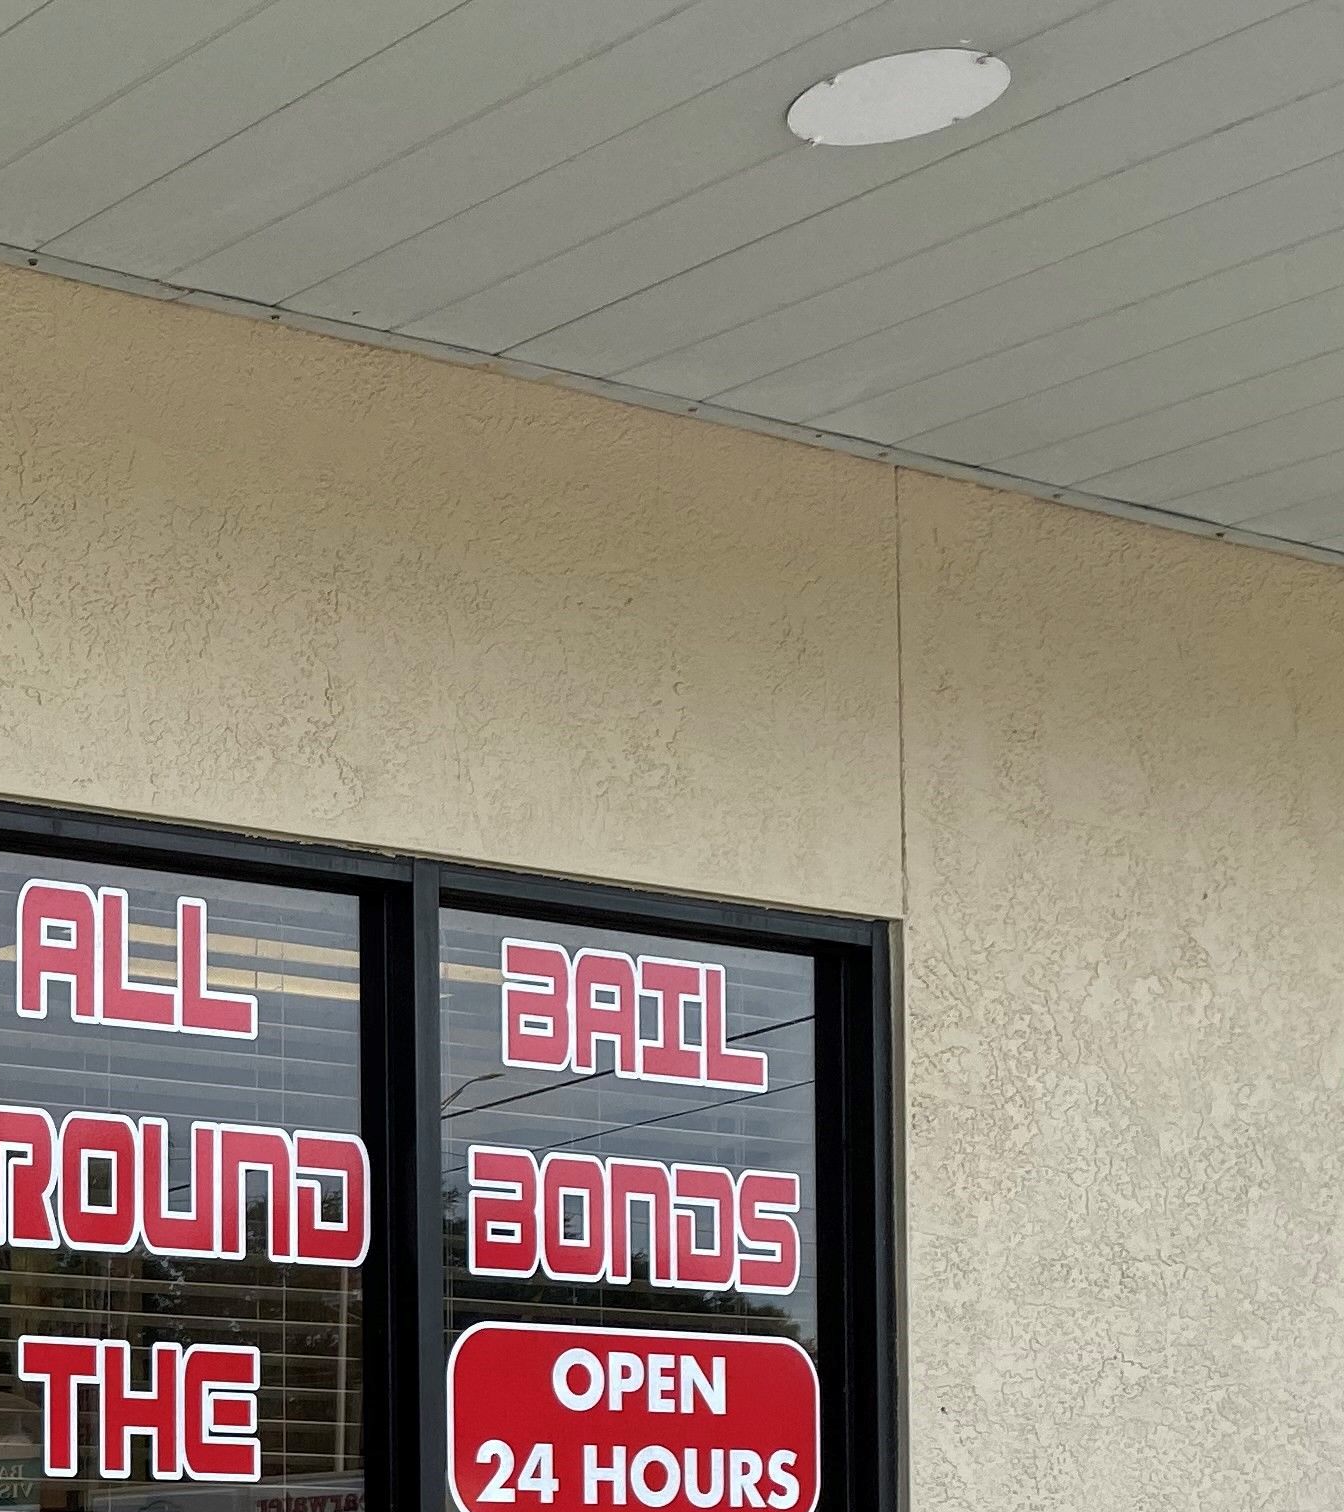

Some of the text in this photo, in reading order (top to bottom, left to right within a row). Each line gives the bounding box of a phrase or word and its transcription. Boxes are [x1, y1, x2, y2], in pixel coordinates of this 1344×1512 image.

[16, 878, 258, 1040] ALL
[502, 937, 768, 1093] BAIL
[468, 1145, 800, 1295] BONDS
[18, 1335, 261, 1482] THE
[552, 1347, 727, 1415] OPEN
[475, 1439, 800, 1510] 24 HOURS
